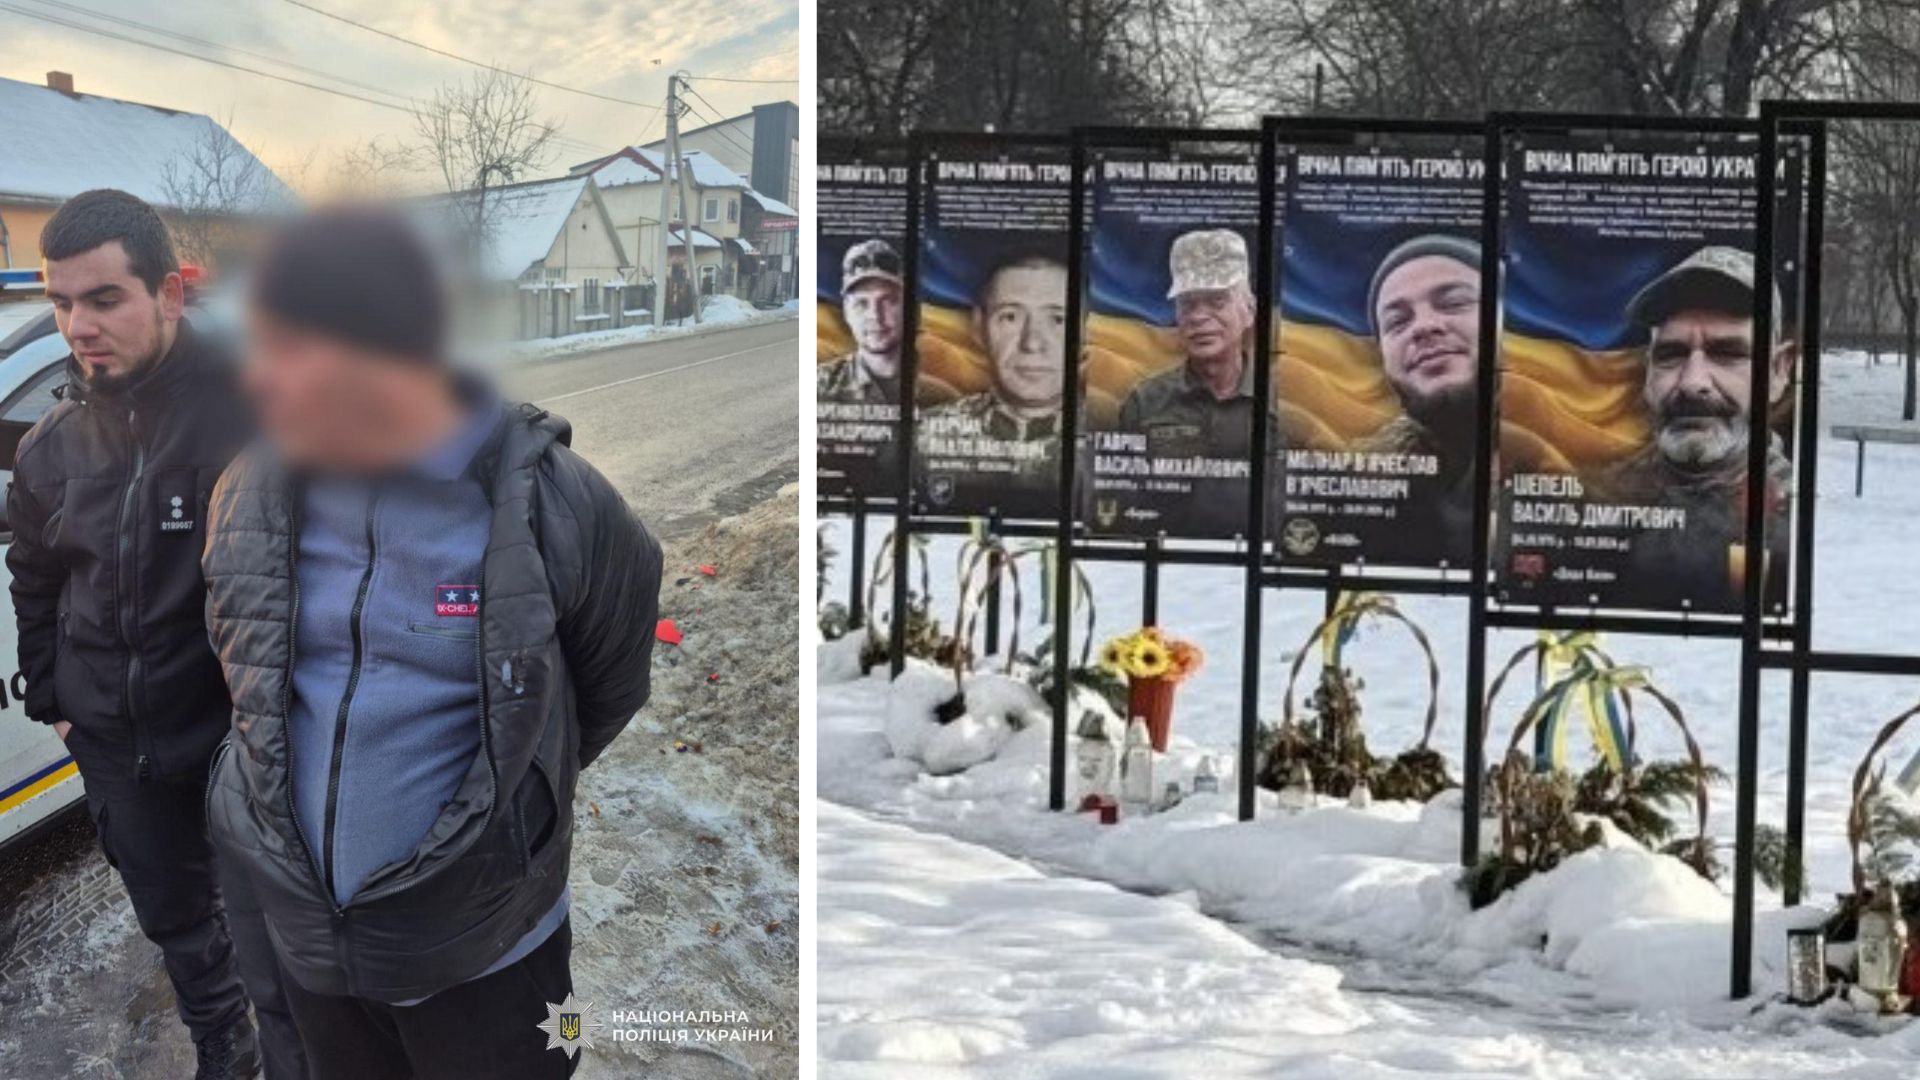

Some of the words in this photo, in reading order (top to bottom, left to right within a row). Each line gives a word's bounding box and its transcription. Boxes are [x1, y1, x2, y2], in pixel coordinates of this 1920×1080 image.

[1037, 164, 1072, 183] ГЕРО
[1211, 164, 1258, 183] ГЕРОЮ
[1298, 156, 1341, 176] ВІЧНА
[1412, 158, 1464, 179] ГЕРОЮ
[1525, 150, 1572, 173] ВІЧНА
[1577, 152, 1649, 176] ПАМ'ЯТЬ
[1652, 154, 1707, 177] ГЕРОЮ
[1711, 154, 1785, 182] УКРАИ
[1513, 472, 1584, 498] ШЕПЕЛЬ
[1511, 500, 1579, 526] ВАСИЛЬ
[1581, 503, 1687, 530] ДМИТРОВИЧ
